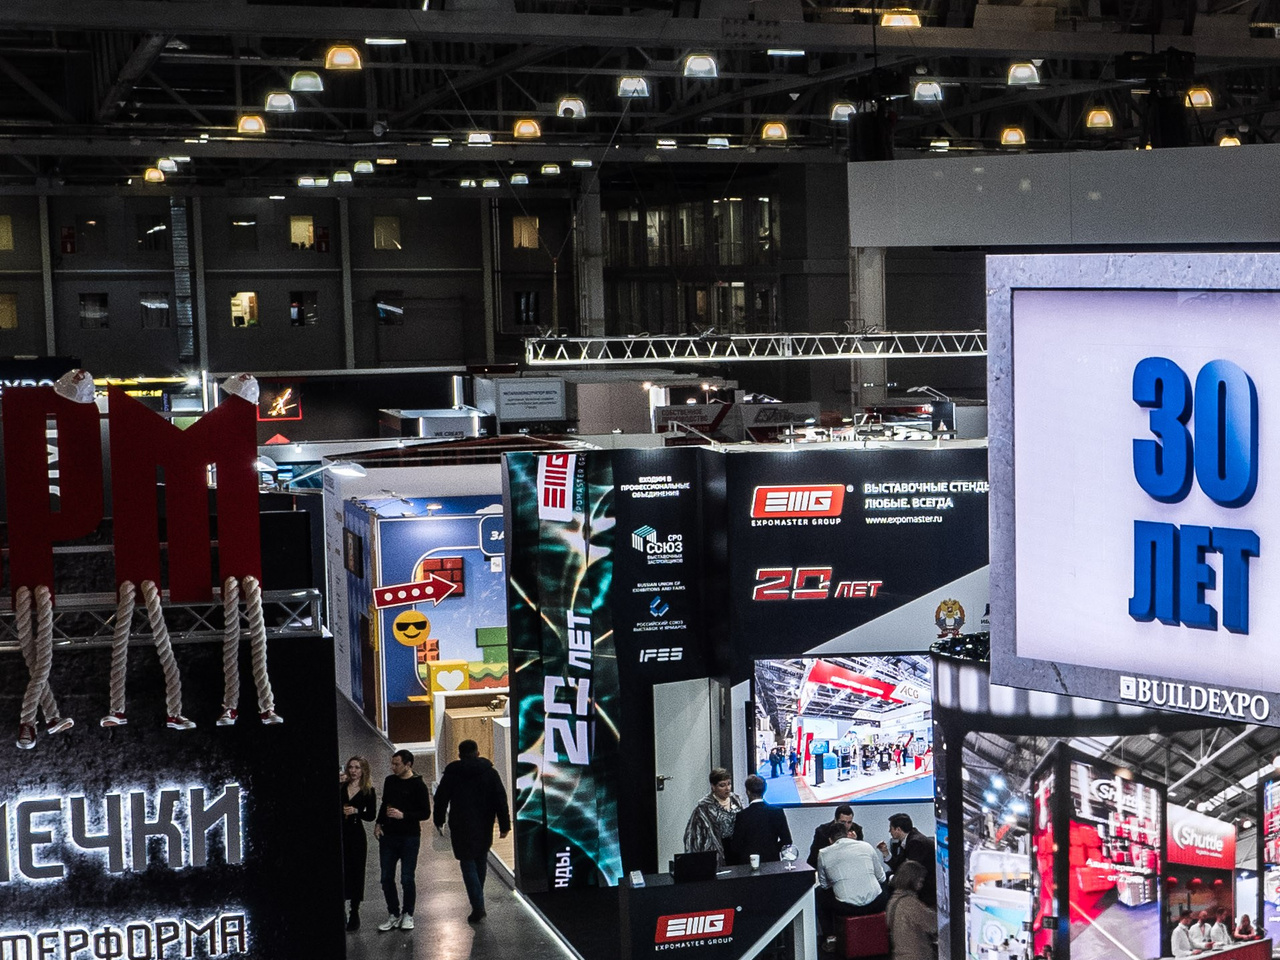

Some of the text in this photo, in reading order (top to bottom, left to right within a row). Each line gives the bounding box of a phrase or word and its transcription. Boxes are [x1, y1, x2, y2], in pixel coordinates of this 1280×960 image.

[1132, 356, 1259, 509] 30
[864, 482, 949, 493] ВЫСТАВОЧНЫЕ
[864, 498, 909, 509] ЛЮБЫЕ.
[751, 517, 842, 527] EXPOMASTER GROUP
[865, 516, 943, 525] www.expomaster.ru
[667, 534, 683, 542] СРО
[646, 542, 683, 554] СОЮЗ
[1128, 519, 1260, 635] ЛЕТ
[835, 580, 884, 598] ЛЕТ
[566, 610, 592, 671] ЛЕТ
[1137, 677, 1271, 721] BUILDEXPO
[0, 783, 242, 882] ЕЧКИ
[1181, 826, 1224, 852] Shuttle
[655, 937, 734, 951] EXPOMASTER GROUP
